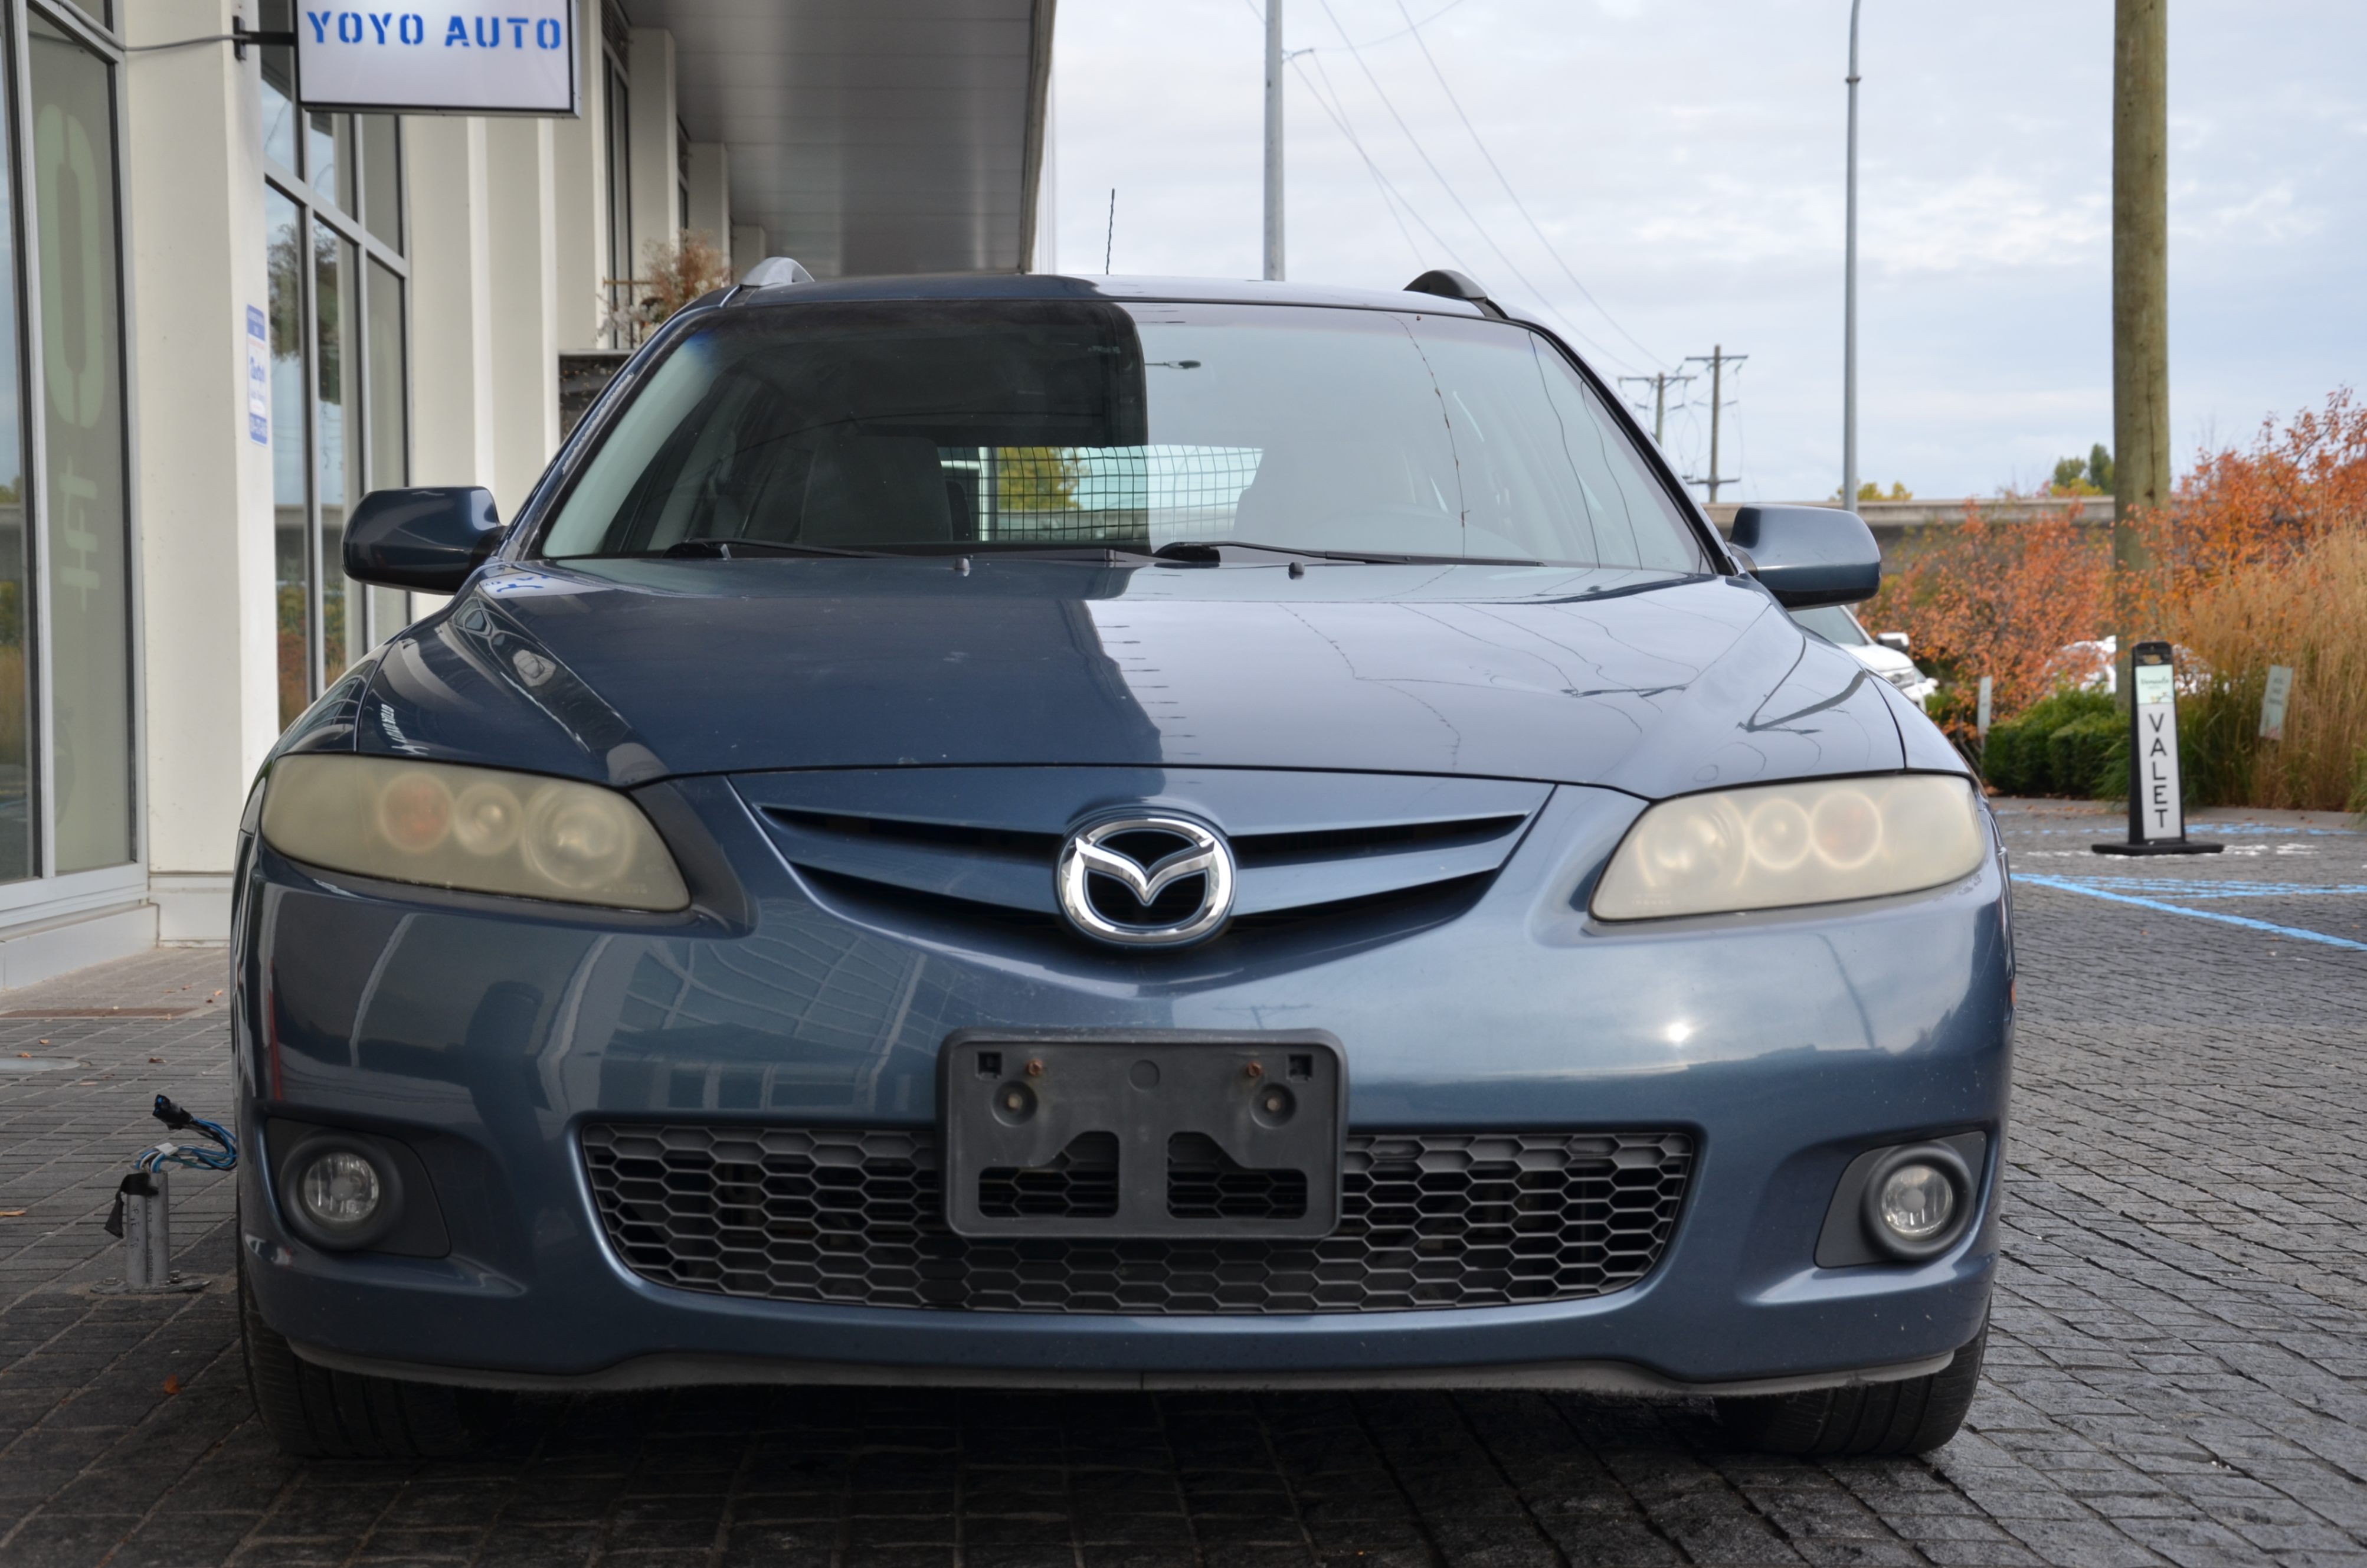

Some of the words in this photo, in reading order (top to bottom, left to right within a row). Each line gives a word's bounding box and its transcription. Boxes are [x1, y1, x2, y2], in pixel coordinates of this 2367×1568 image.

[306, 11, 424, 45] YOYO
[444, 15, 561, 50] AUTO
[2148, 713, 2168, 828] VALET
